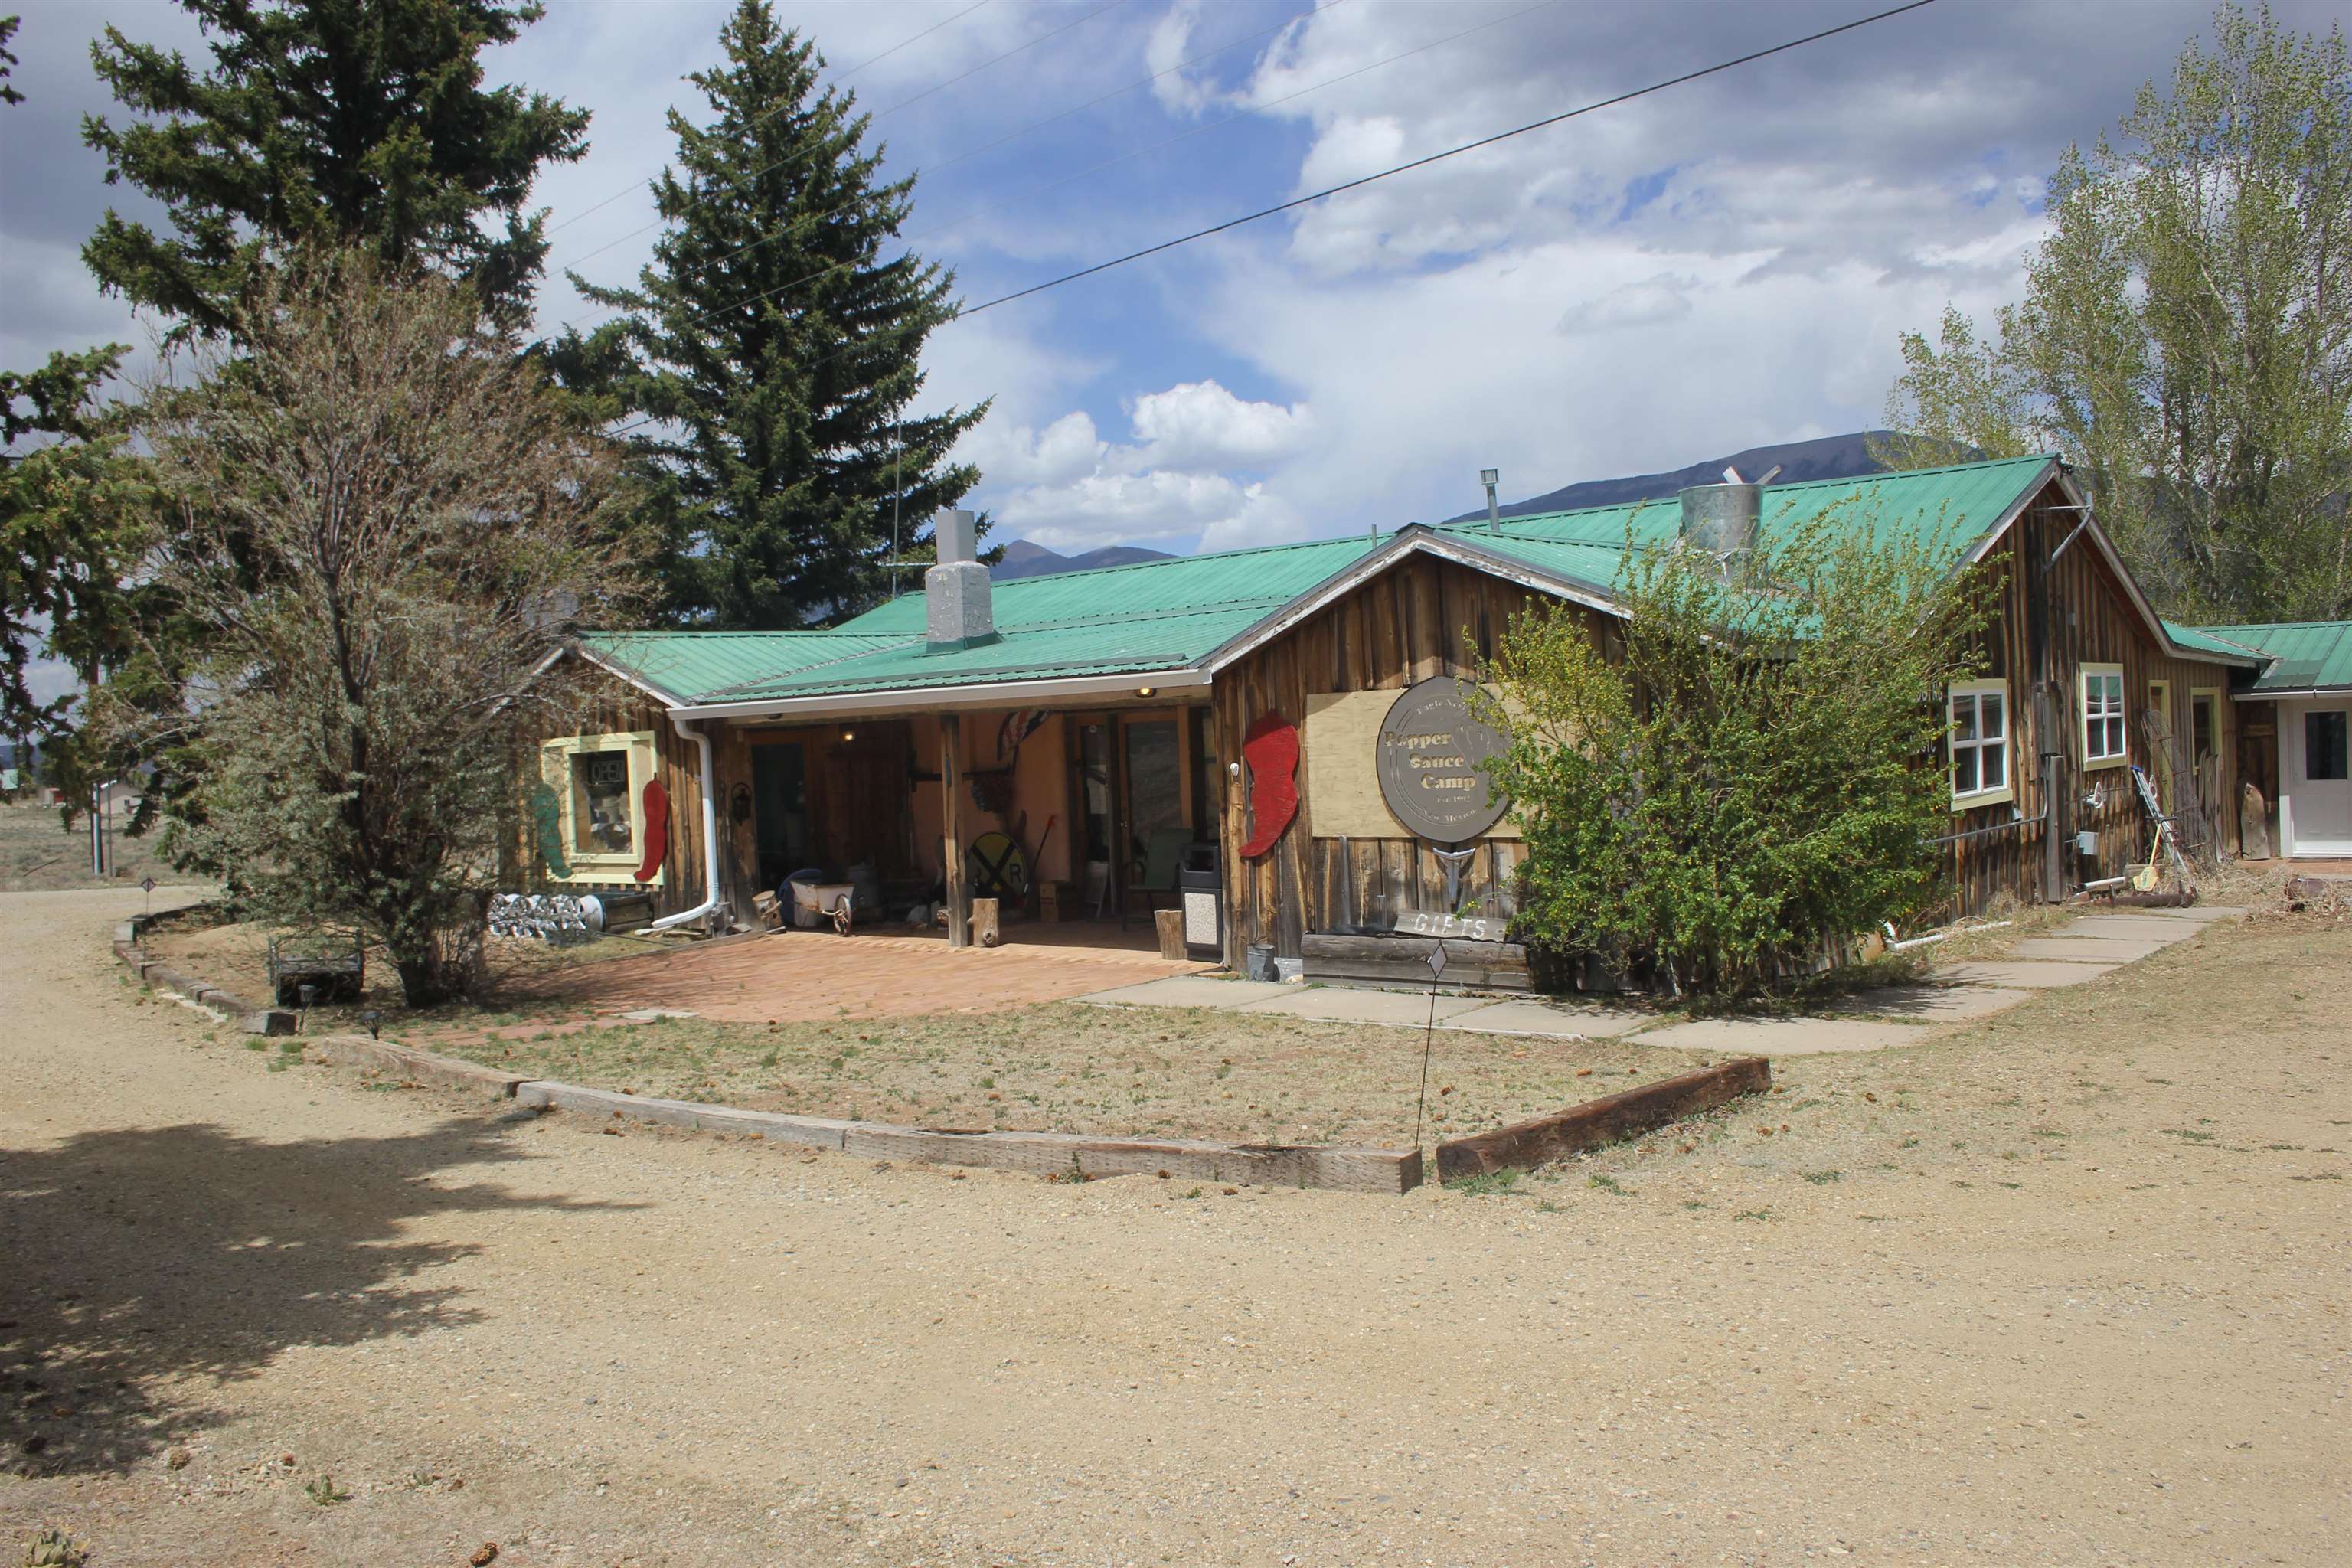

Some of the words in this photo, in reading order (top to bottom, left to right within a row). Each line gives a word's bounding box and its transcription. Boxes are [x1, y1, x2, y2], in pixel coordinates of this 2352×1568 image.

[1384, 731, 1451, 750] Pepper
[1409, 753, 1464, 769] Sauce
[1421, 773, 1476, 791] Camp
[1445, 808, 1477, 822] Mexico
[1415, 913, 1487, 938] GIFTS
